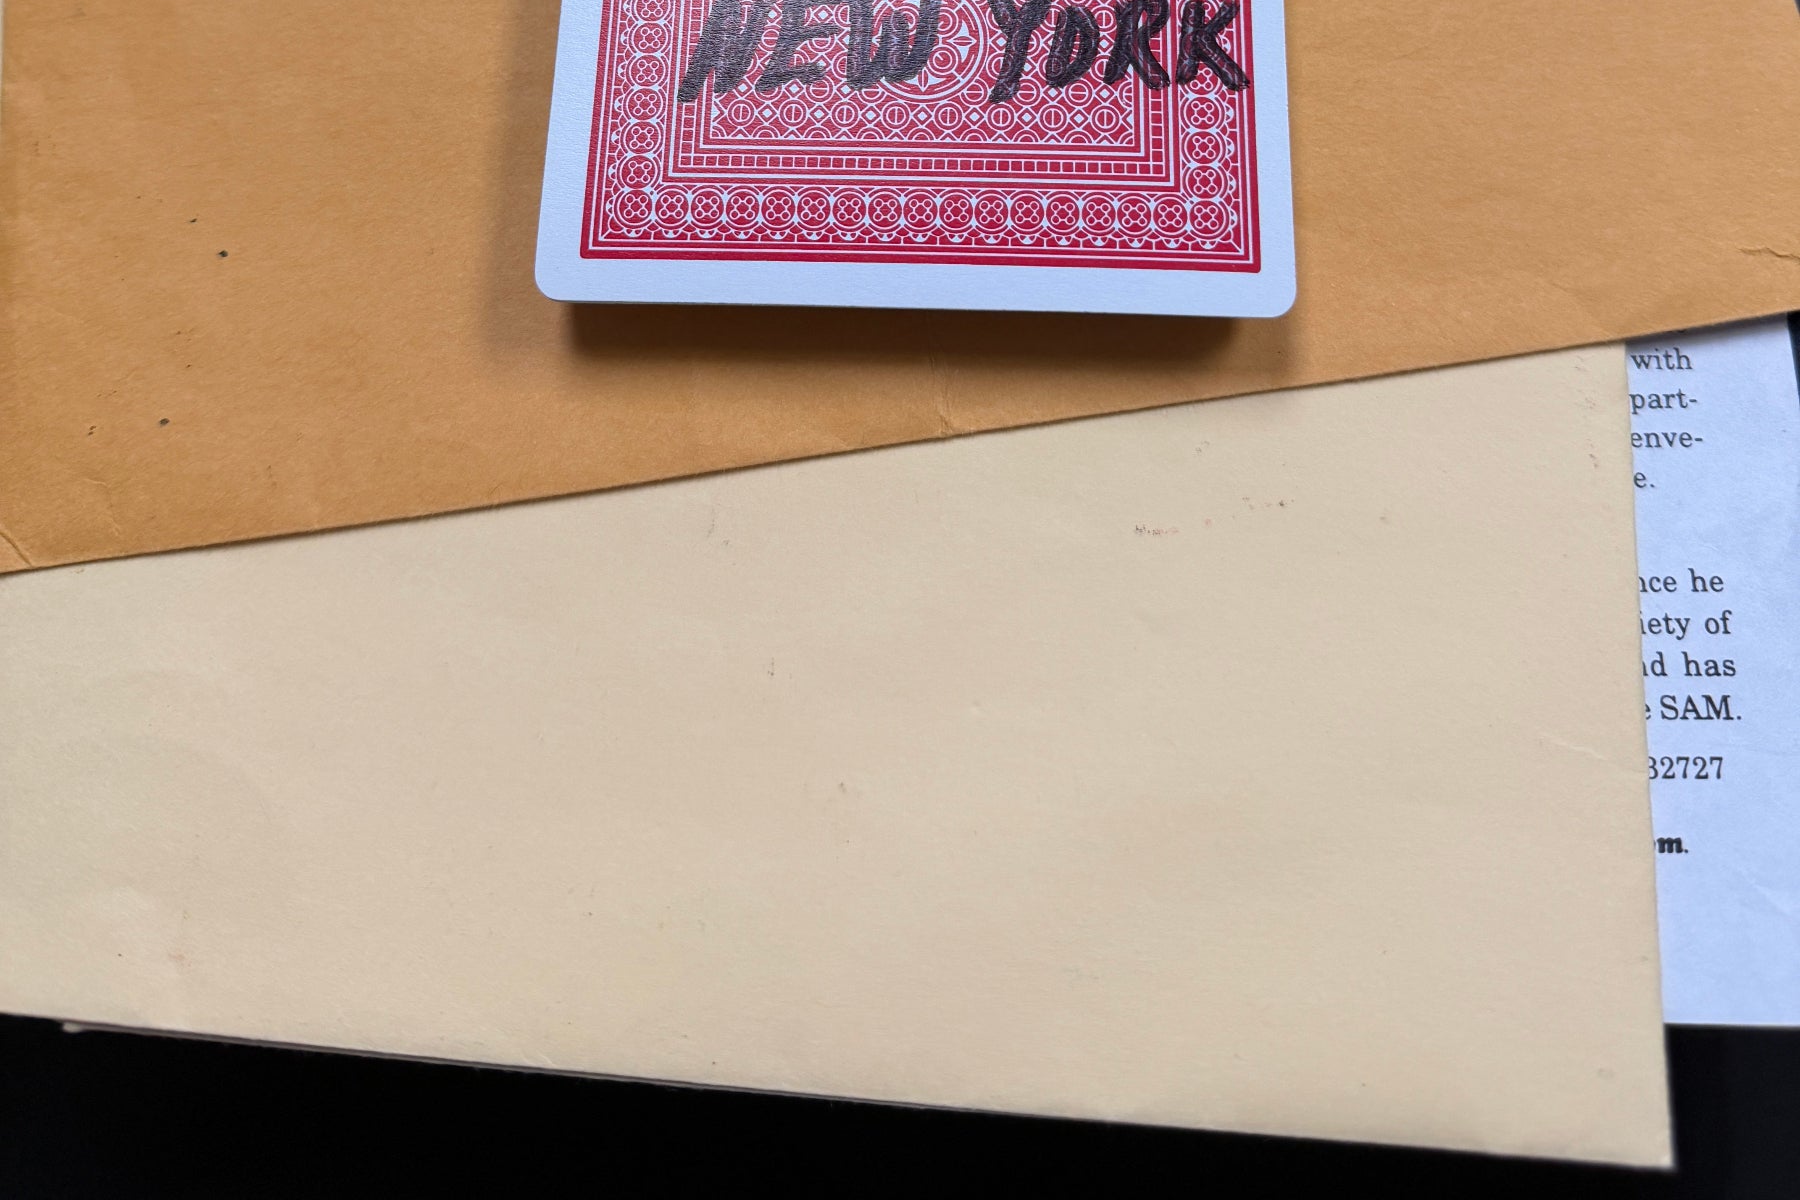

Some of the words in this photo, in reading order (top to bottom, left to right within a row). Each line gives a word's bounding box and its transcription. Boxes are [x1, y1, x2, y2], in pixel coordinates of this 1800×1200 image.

[1630, 347, 1693, 370] with
[1629, 388, 1698, 415] part-
[1630, 431, 1704, 448] enve-
[1687, 567, 1725, 593] he
[1704, 609, 1733, 635] of
[1681, 651, 1737, 677] has
[1659, 694, 1743, 721] SAM.
